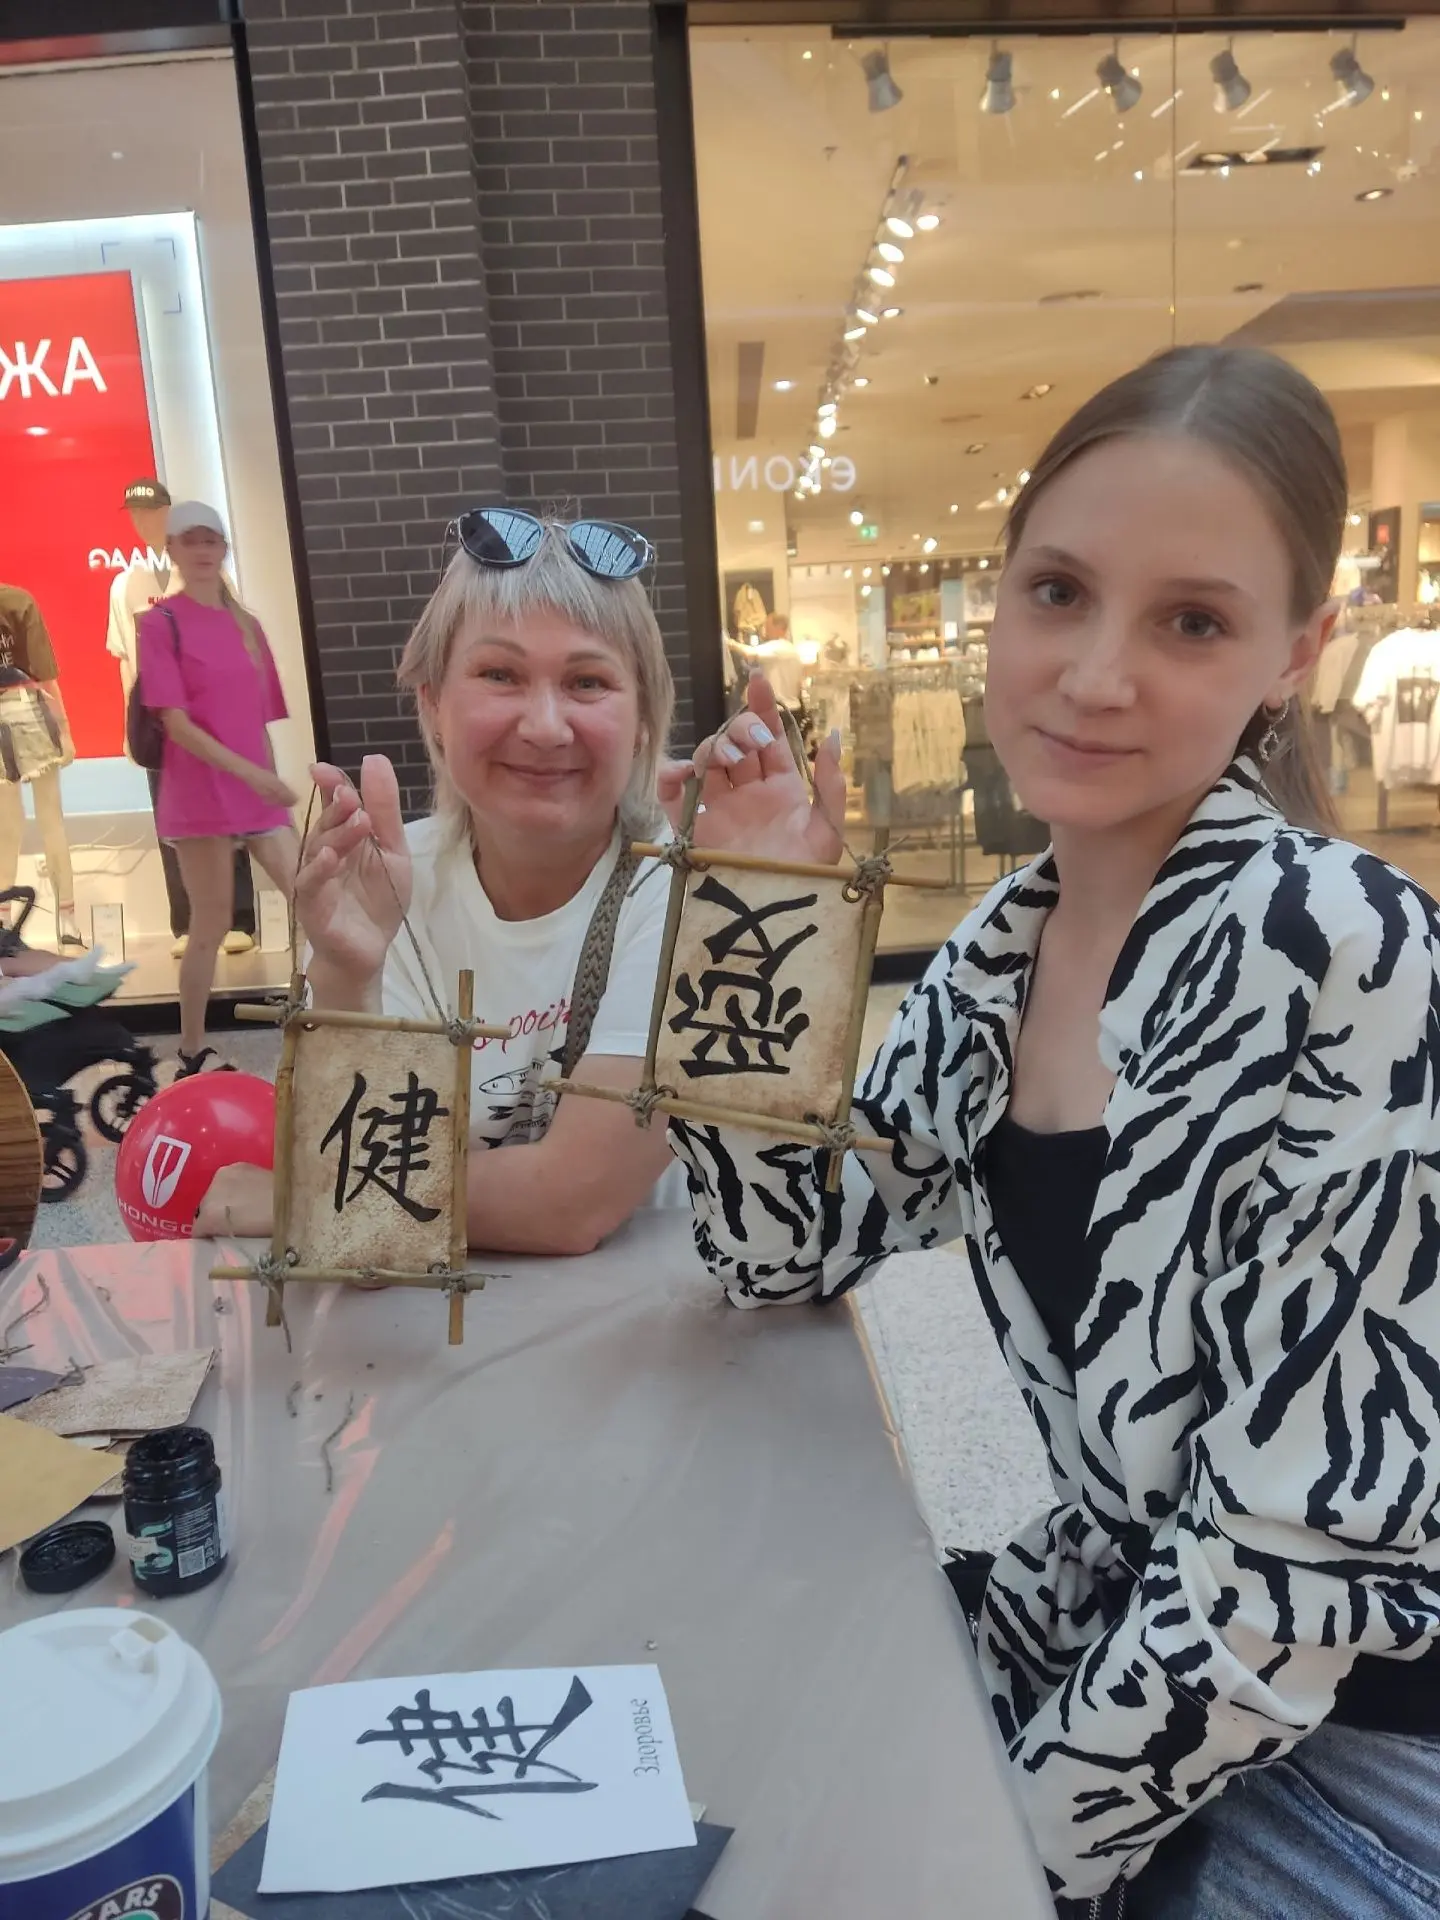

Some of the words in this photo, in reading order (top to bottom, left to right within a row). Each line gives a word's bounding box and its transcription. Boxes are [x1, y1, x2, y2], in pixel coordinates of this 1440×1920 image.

[668, 875, 819, 1079] 愛
[320, 1070, 450, 1222] 健
[356, 1675, 600, 1821] 健
[630, 1698, 664, 1778] Здоровье
